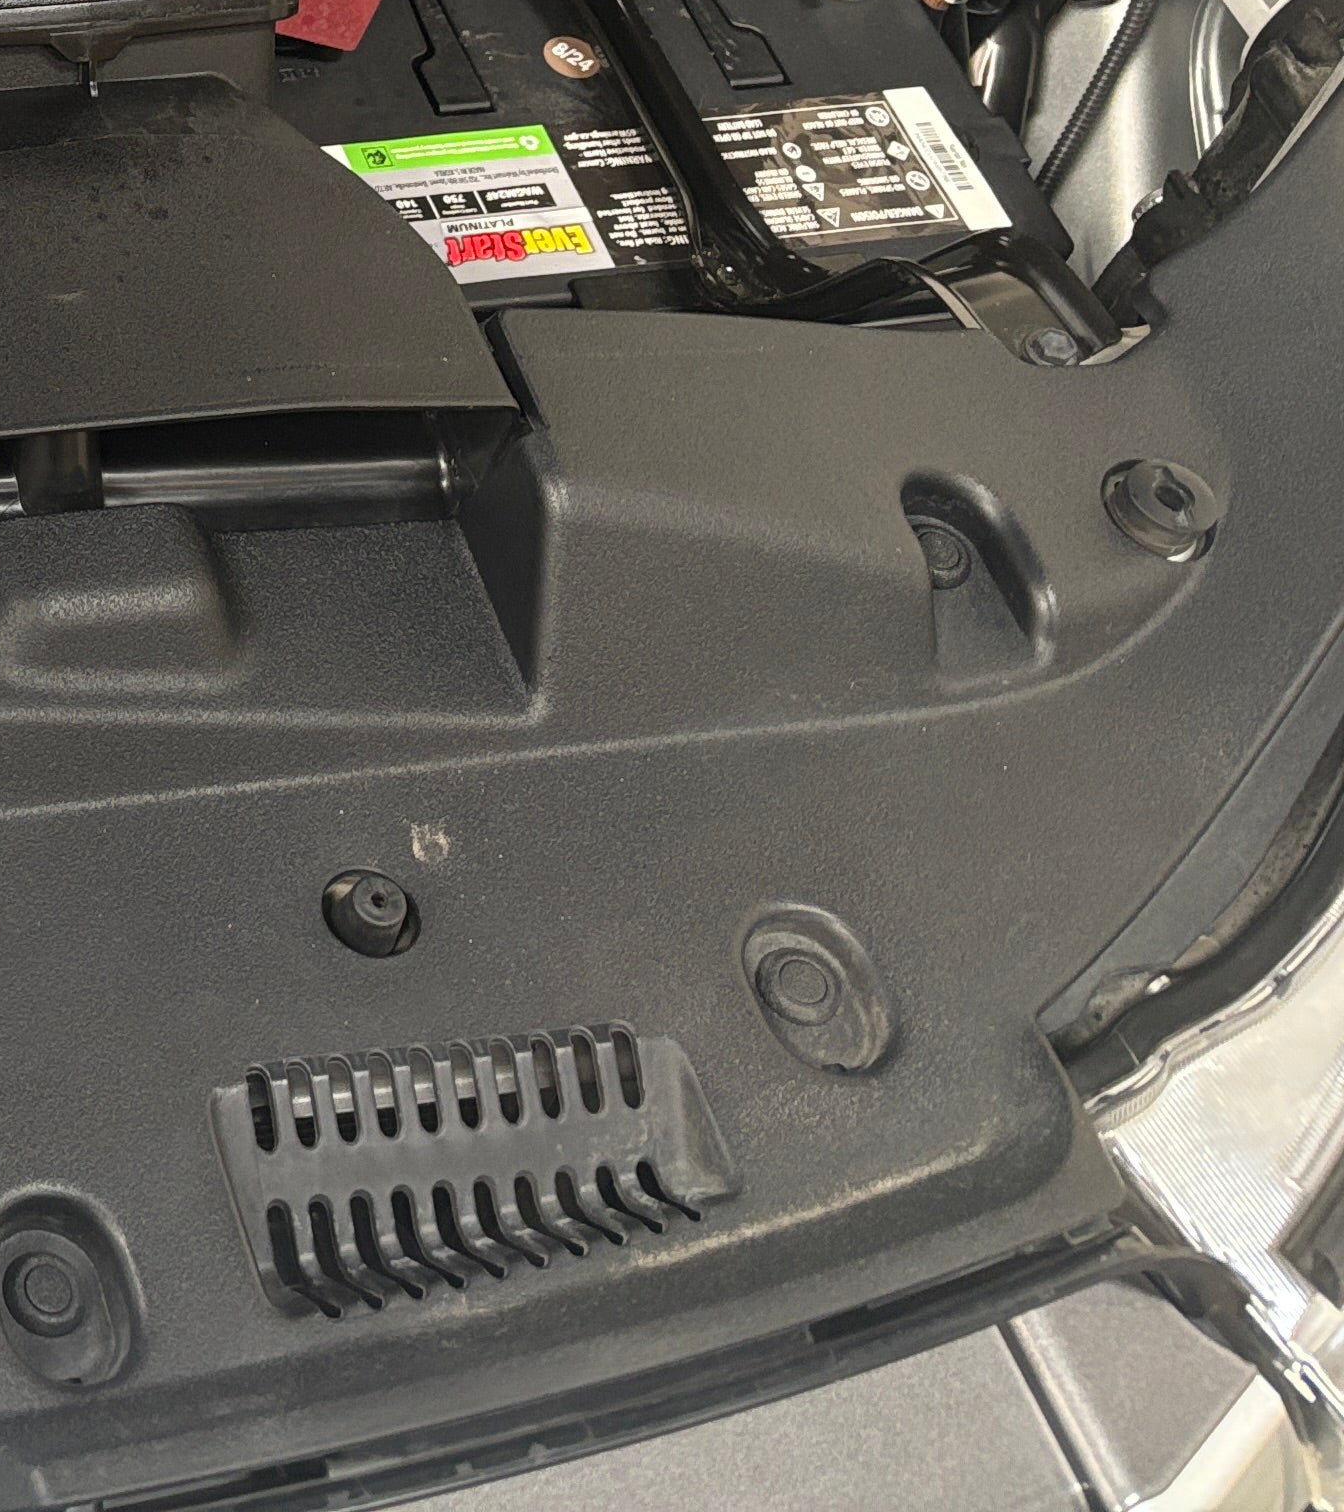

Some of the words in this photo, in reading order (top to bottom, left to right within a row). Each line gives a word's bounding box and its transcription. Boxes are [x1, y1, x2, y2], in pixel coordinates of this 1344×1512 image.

[551, 41, 597, 73] 8/24
[443, 194, 466, 205] 750
[446, 218, 515, 234] PLATINUM
[444, 224, 594, 268] EverStart
